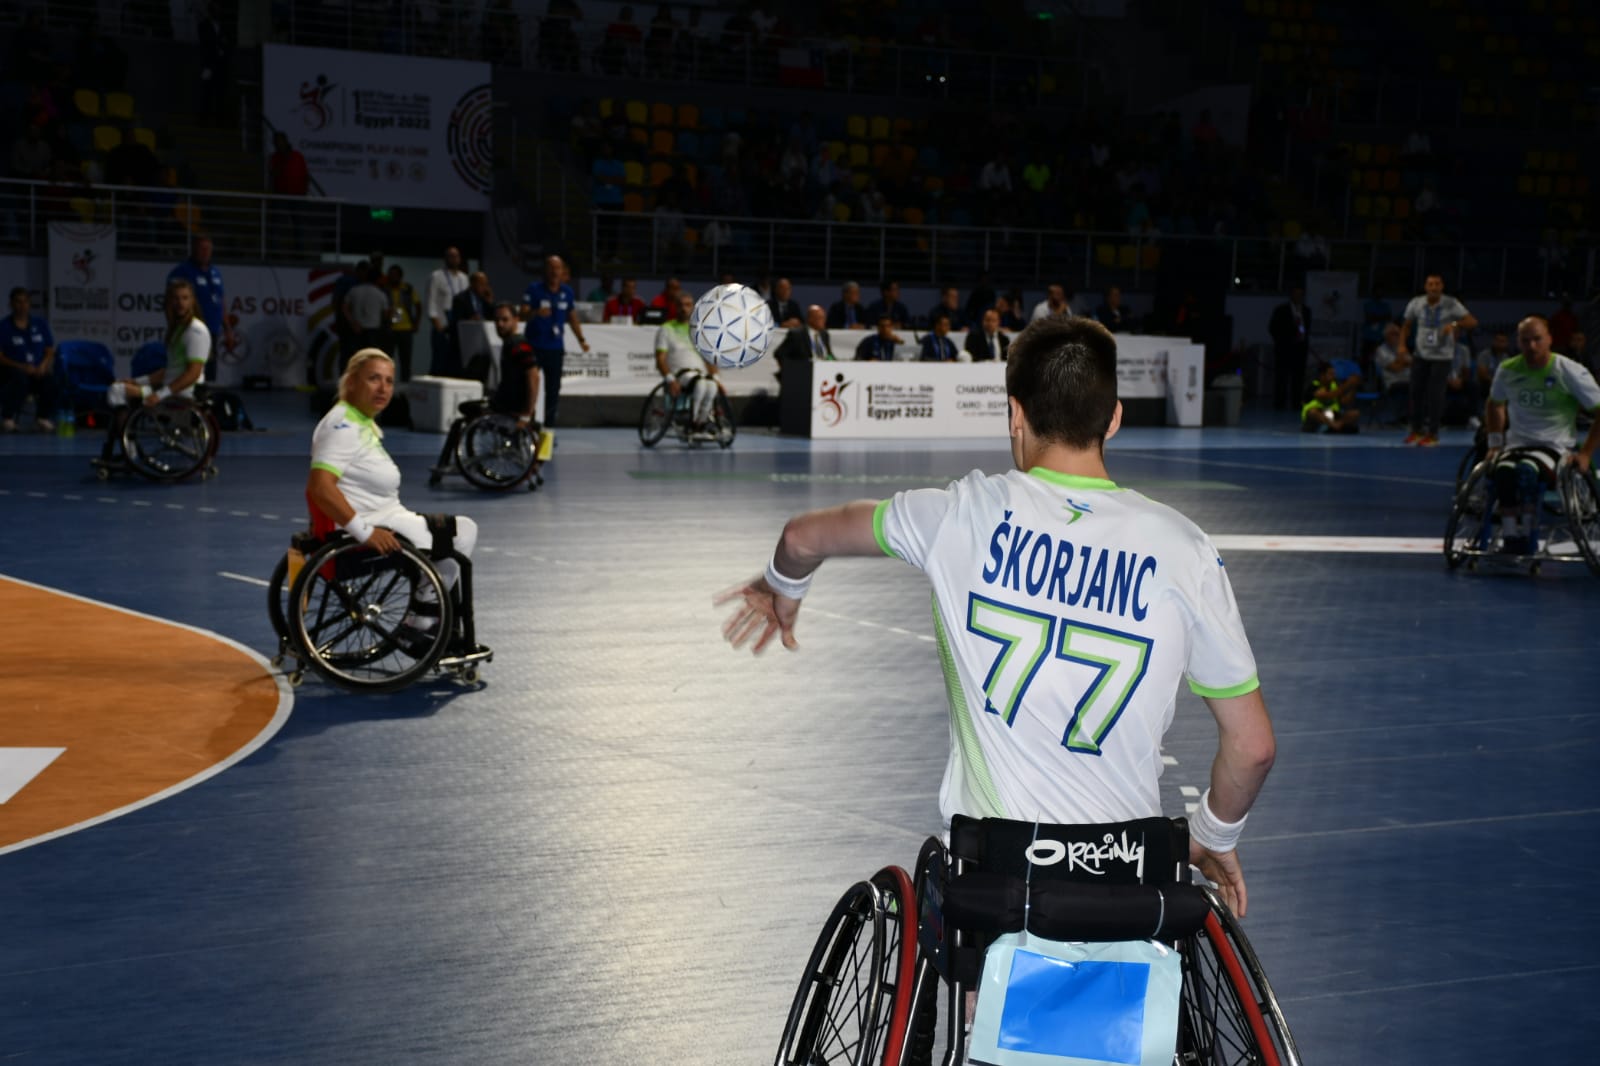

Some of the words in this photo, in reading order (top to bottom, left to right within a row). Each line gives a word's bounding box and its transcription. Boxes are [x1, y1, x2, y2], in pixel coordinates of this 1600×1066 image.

[355, 113, 394, 129] Egypt
[397, 116, 431, 130] 2022
[231, 296, 257, 313] AS
[262, 297, 305, 316] ONE
[955, 400, 981, 410] CAIRO
[1519, 390, 1545, 408] 33
[867, 406, 901, 420] Egypt
[904, 406, 934, 418] 2022
[982, 509, 1158, 623] ŠKORJANC
[966, 590, 1155, 758] 77
